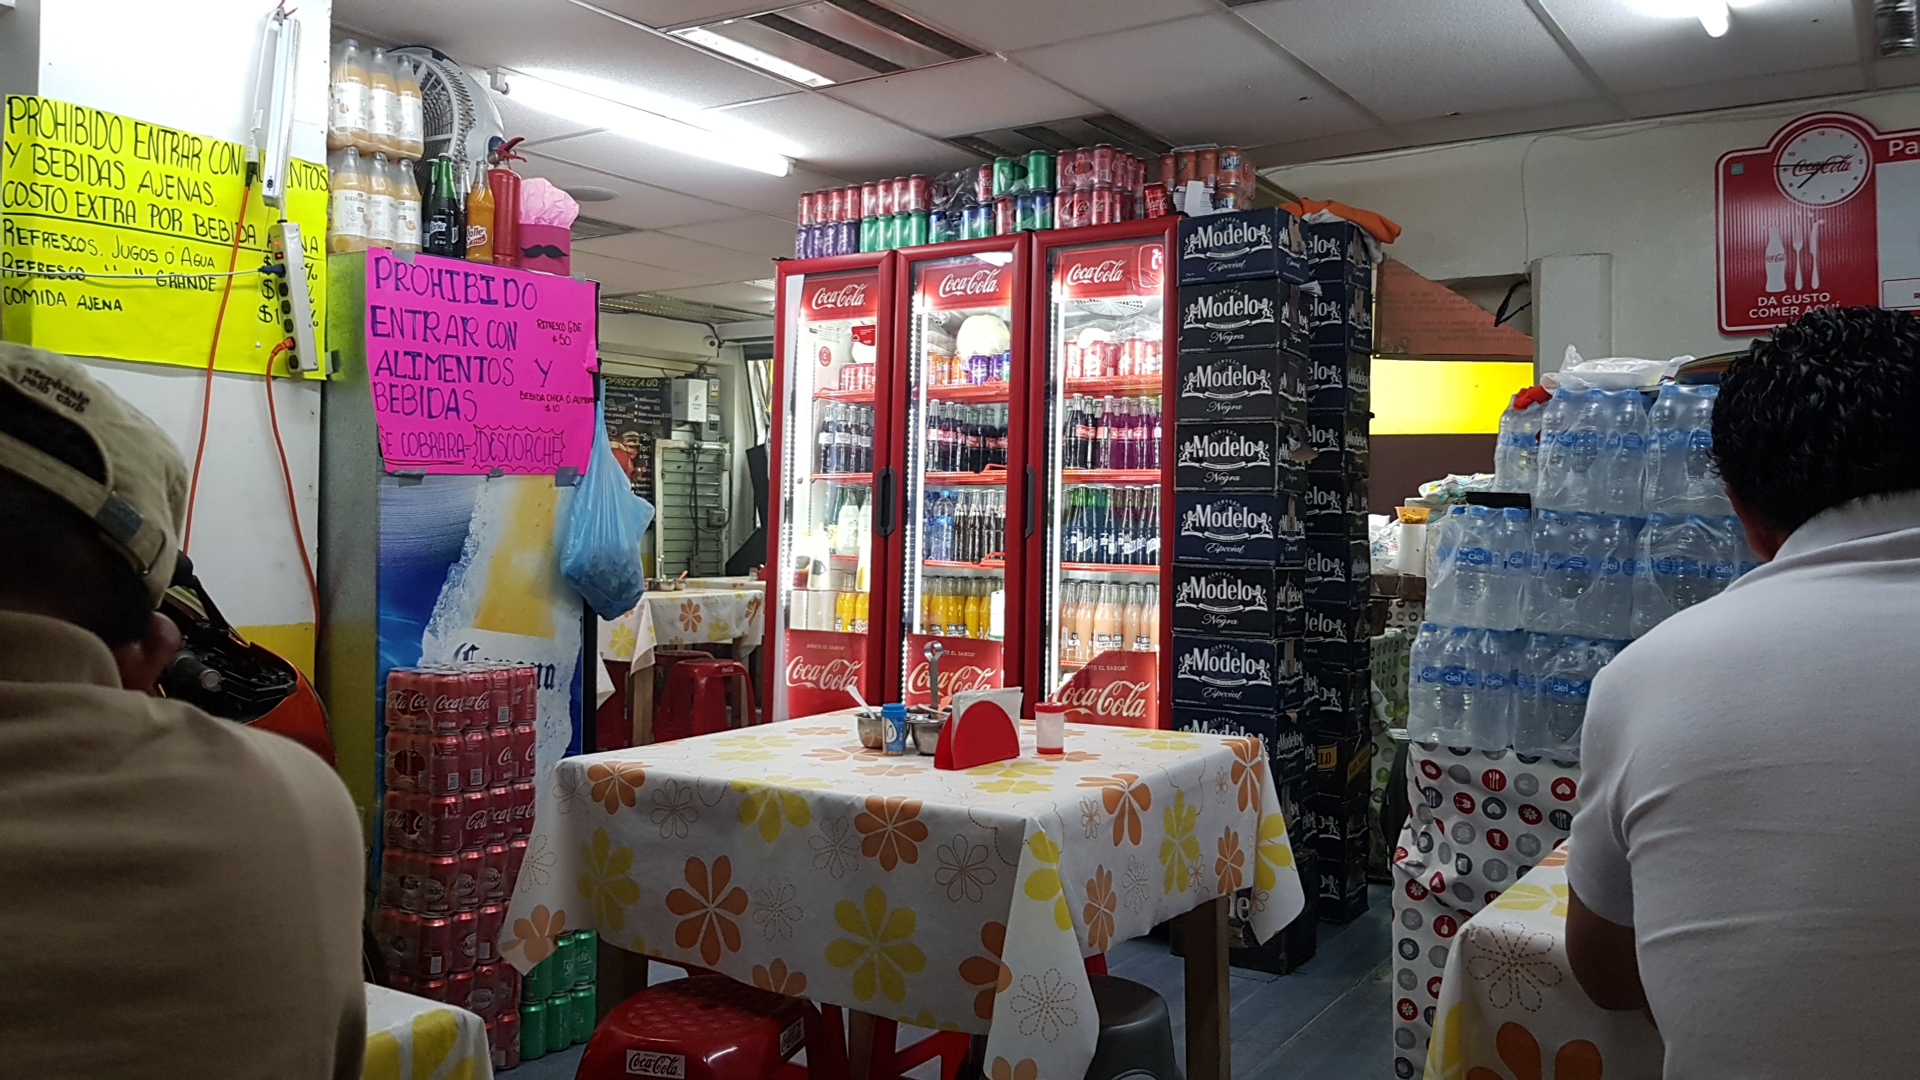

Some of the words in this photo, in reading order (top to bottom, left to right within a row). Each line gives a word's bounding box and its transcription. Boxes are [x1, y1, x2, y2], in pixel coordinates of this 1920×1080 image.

[7, 96, 124, 155] PROHIBIDO
[134, 122, 202, 174] ENTRAR
[208, 141, 241, 176] CON
[5, 141, 23, 169] Y
[31, 143, 125, 190] BEBIDAS
[138, 170, 218, 207] AJENAS.
[3, 181, 68, 213] COSTO
[75, 191, 136, 225] EXTRA
[150, 203, 182, 232] POR
[194, 214, 256, 245] BEBIDA
[1197, 222, 1257, 249] Modelo
[111, 235, 158, 263] JUGOS
[181, 247, 215, 269] AGUA
[2, 252, 85, 281] REFRESCO
[156, 269, 217, 292] GRANDE
[1067, 259, 1127, 287] Coca-Cola
[1207, 260, 1246, 273] Especial
[374, 256, 538, 311] PROHIBIDO
[939, 269, 1001, 298] Coca-Cola
[3, 286, 67, 308] COMIDA
[77, 296, 123, 311] AJENA
[812, 283, 868, 310] Coca-Cola
[1197, 294, 1259, 320] Modelo
[1758, 296, 1778, 307] DA
[1782, 292, 1830, 305] GUSTO
[1749, 306, 1799, 318] COMER
[370, 304, 479, 348] ENTRAR
[486, 318, 518, 351] CON
[1208, 331, 1246, 345] Negra
[374, 349, 514, 386] ALIMENTOS
[534, 358, 553, 388] Y
[1196, 364, 1257, 388] Modelo
[372, 381, 478, 422] BEBIDAS
[520, 390, 545, 402] BEBIDA
[1206, 402, 1243, 415] Negra
[1193, 434, 1254, 458] Modelo
[1204, 472, 1241, 486] Negra
[1195, 504, 1257, 528] Modelo
[1205, 543, 1245, 554] Especial
[1190, 576, 1251, 601] Modelo
[1201, 614, 1238, 627] Negra
[786, 656, 863, 691] Coca-Cola
[1193, 648, 1256, 675] Modelo
[1445, 672, 1462, 682] ciel
[1202, 688, 1243, 700] Especial
[629, 1053, 679, 1075] Coca-Cola
